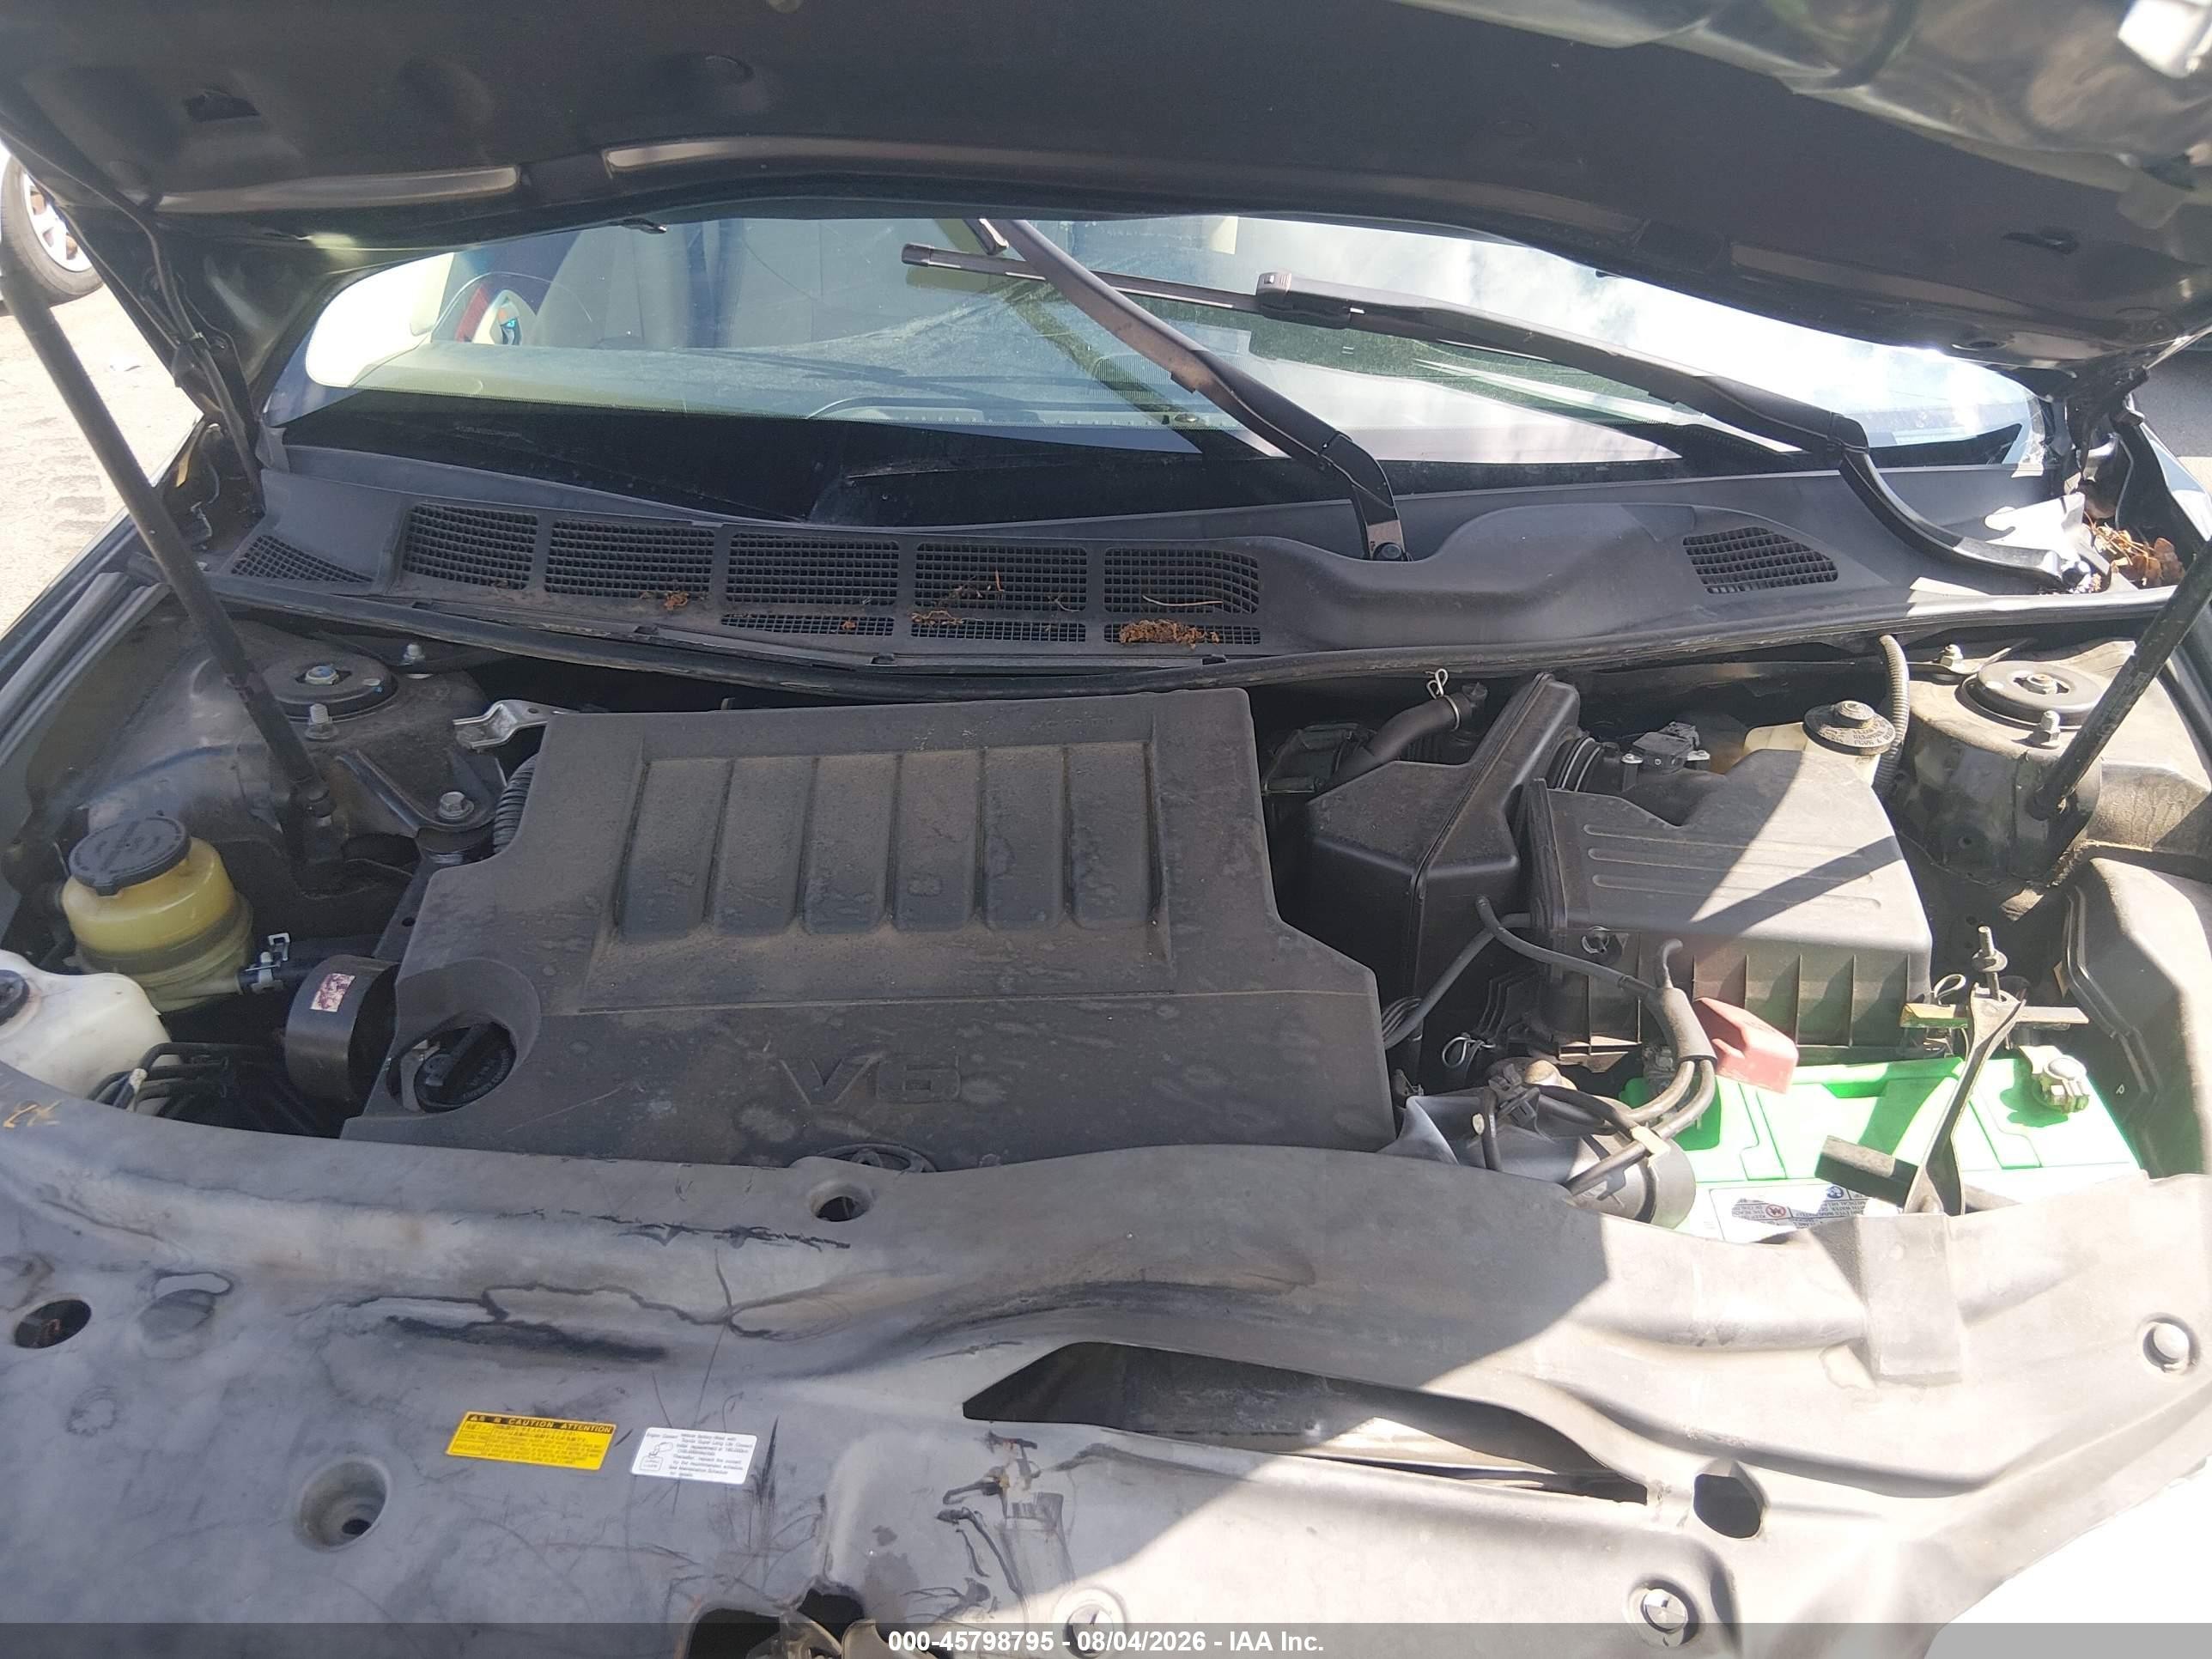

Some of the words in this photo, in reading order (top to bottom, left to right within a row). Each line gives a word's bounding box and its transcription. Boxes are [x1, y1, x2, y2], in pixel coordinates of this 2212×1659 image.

[779, 1050, 963, 1105] V6
[507, 1419, 554, 1428] CAUTION
[561, 1422, 612, 1433] ATTENTION
